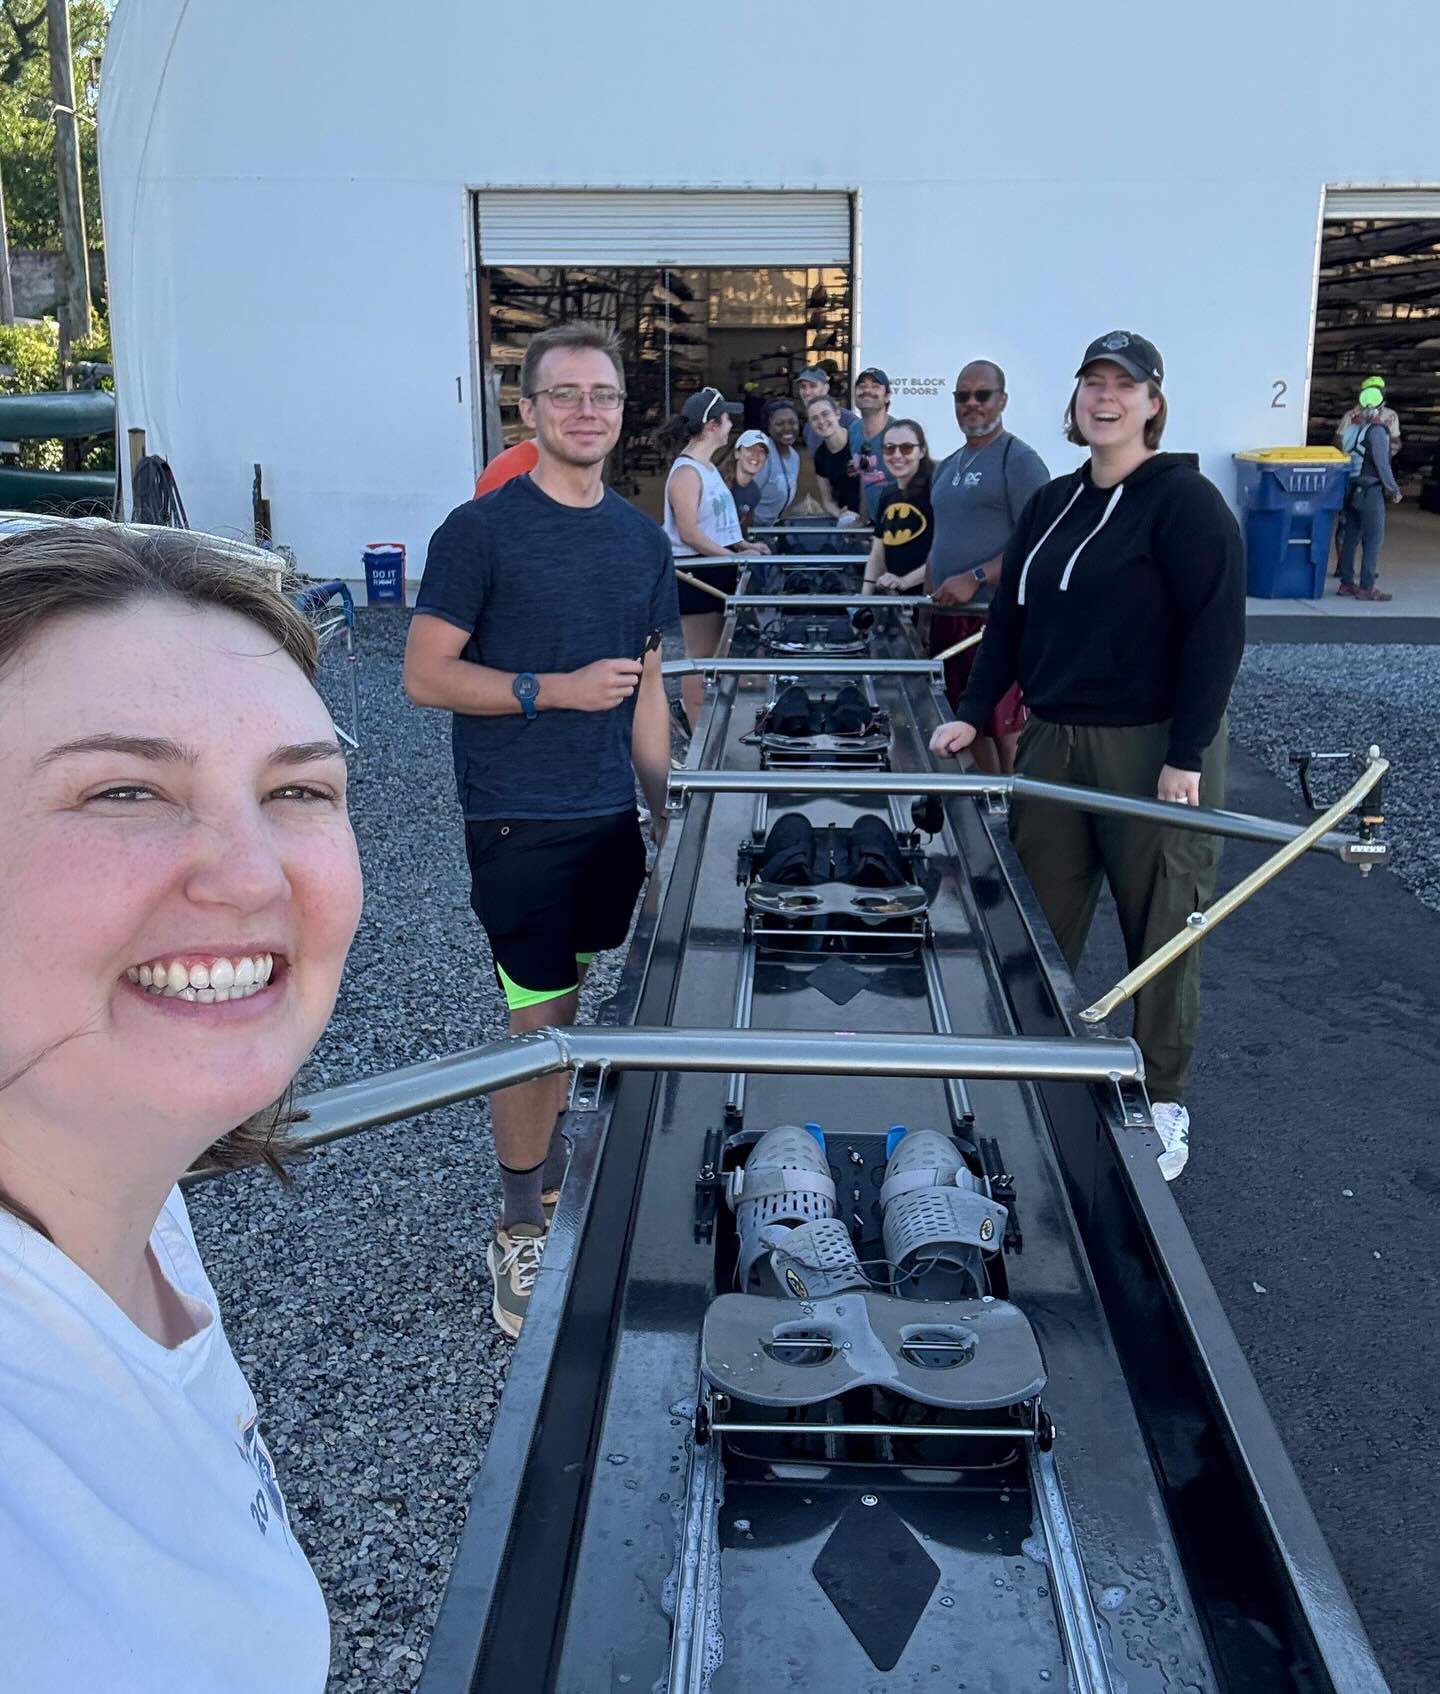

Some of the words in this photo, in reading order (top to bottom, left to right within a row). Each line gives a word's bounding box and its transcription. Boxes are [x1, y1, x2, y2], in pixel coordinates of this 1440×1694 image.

[911, 378, 946, 386] BLOCK
[456, 376, 462, 403] 1
[903, 387, 938, 395] DOORS
[1271, 380, 1287, 408] 2
[373, 570, 386, 578] DO
[387, 570, 396, 578] IT
